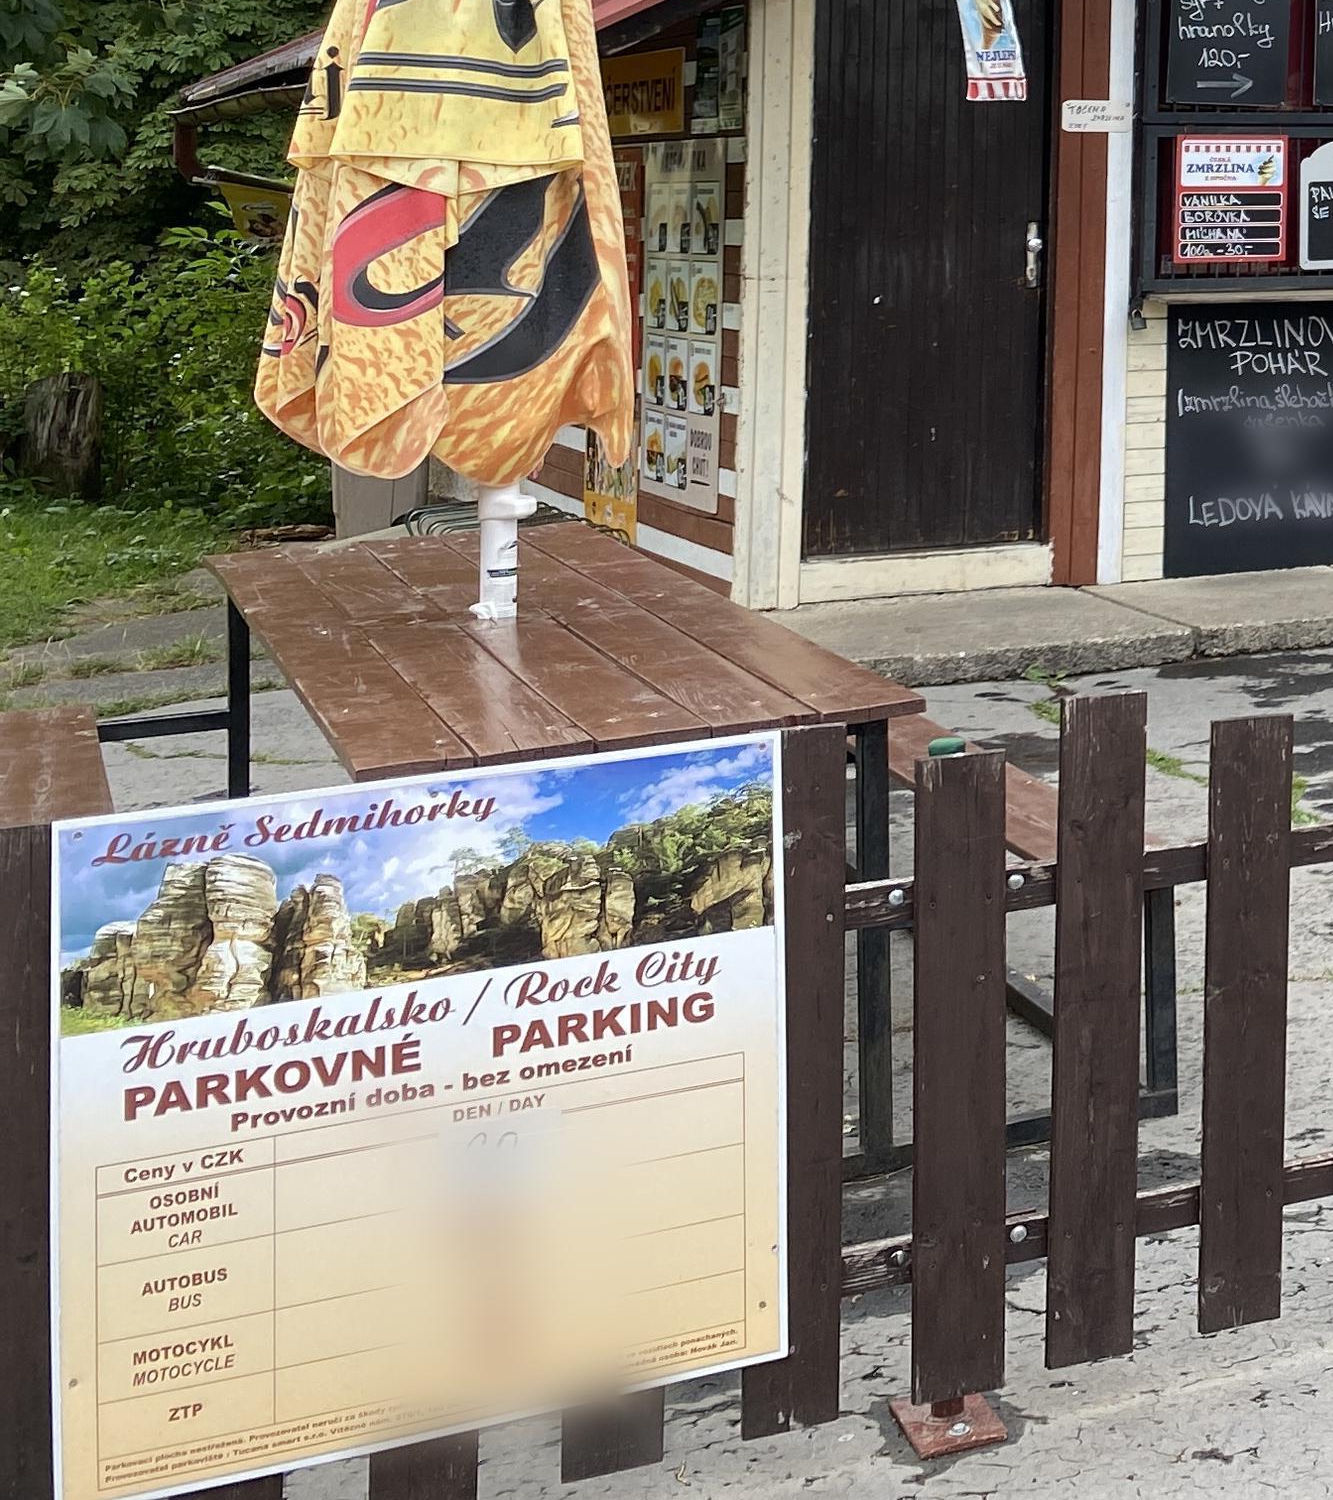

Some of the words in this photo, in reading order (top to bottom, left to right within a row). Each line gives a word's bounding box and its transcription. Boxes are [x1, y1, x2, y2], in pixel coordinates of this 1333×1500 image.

[1178, 12, 1275, 48] hranolky
[604, 66, 677, 116] ČERSTVENÍ
[1186, 163, 1254, 174] ZMRZLINA
[1183, 194, 1241, 207] VANILKA
[92, 823, 235, 866] Lázně
[244, 790, 498, 847] Sedmihorky
[120, 988, 456, 1074] Hruboskalsko
[504, 960, 621, 1009] Rock
[636, 951, 722, 987] City
[124, 1032, 422, 1121] PARKOVNÉ
[492, 991, 715, 1058] PARKING
[231, 1092, 356, 1132] Provozní
[365, 1081, 435, 1108] doba
[462, 1070, 511, 1092] bez
[519, 1044, 632, 1080] omezení
[452, 1103, 492, 1123] DEN
[509, 1094, 546, 1112] DAY
[124, 1164, 175, 1184] Ceny
[183, 1161, 193, 1173] v
[200, 1148, 244, 1170] CZK
[149, 1182, 220, 1210] OSOBNÍ
[131, 1203, 238, 1235] AUTOMOBIL
[168, 1229, 202, 1248] CAR
[141, 1268, 228, 1296] AUTOBUS
[168, 1293, 202, 1312] BUS
[133, 1334, 234, 1365] MOTOCYKL
[132, 1353, 236, 1387] MOTOCYCLE
[168, 1403, 203, 1422] ZTP
[249, 1423, 310, 1443] Provozovatel
[105, 1463, 169, 1483] Provozovatel
[272, 1436, 301, 1448] smart
[304, 1431, 327, 1442] s.r.o.
